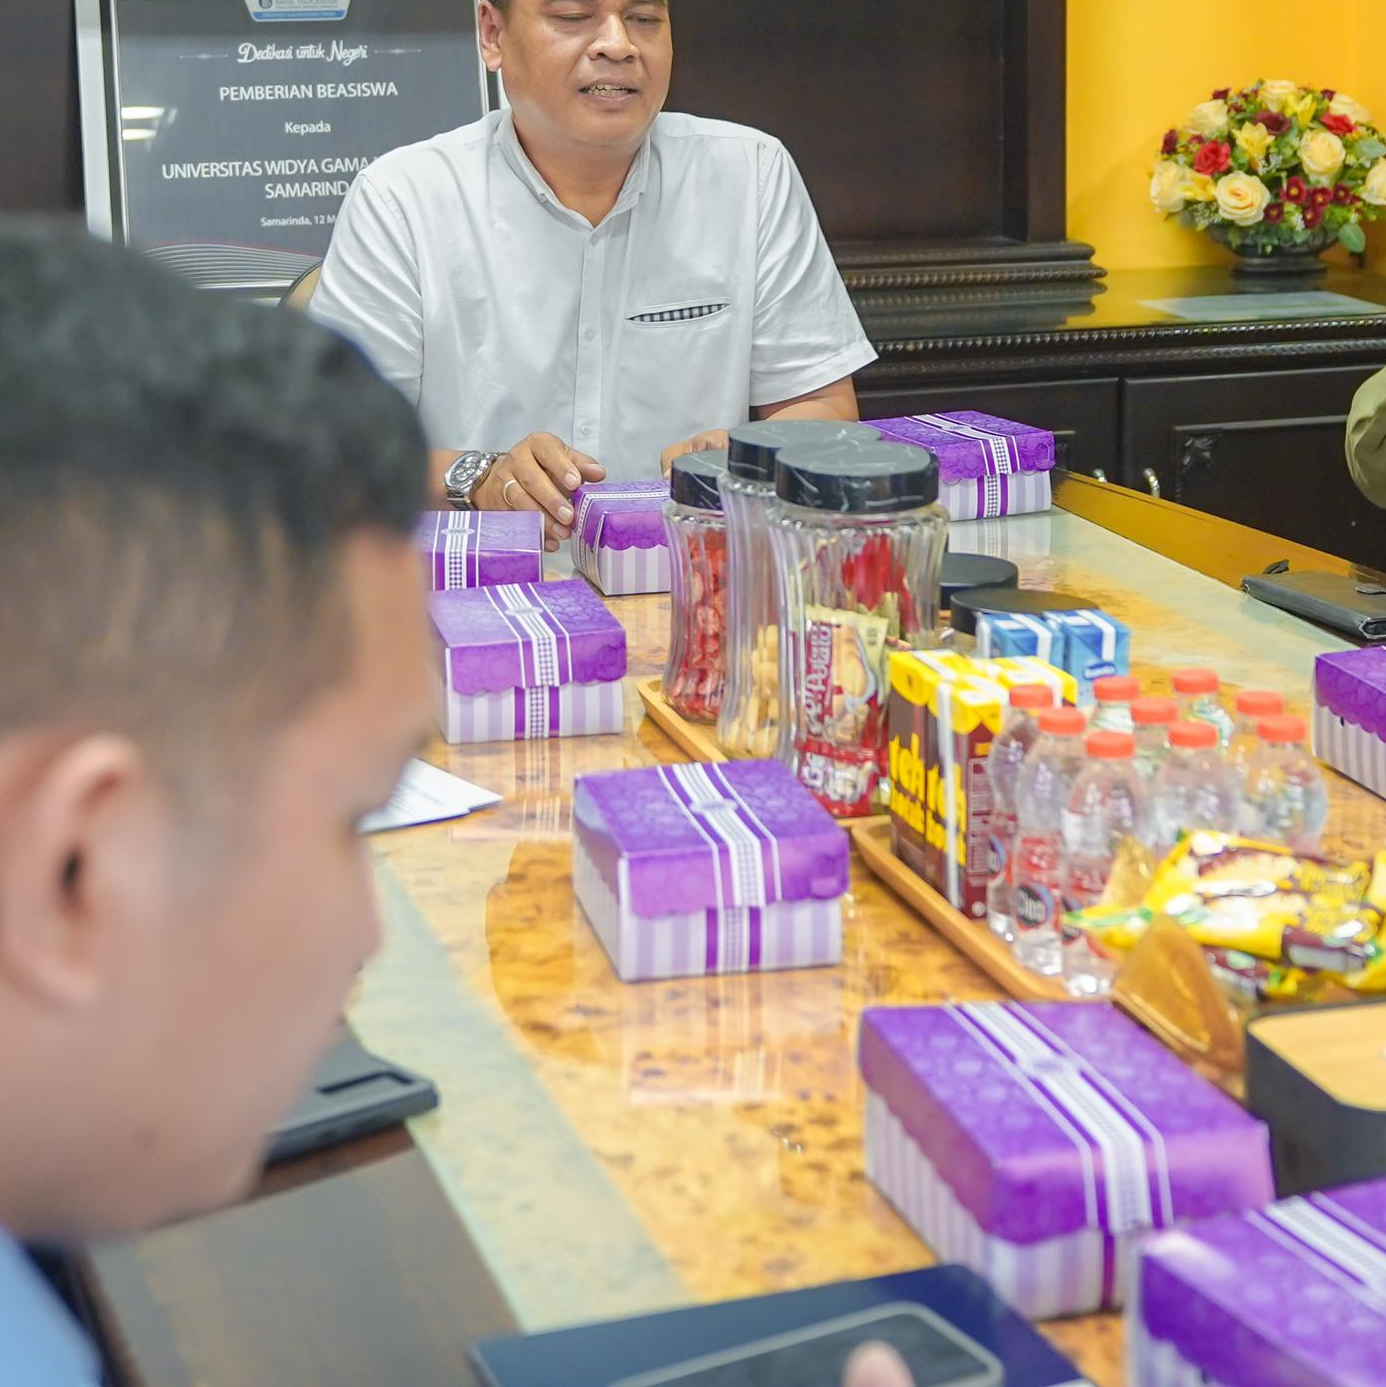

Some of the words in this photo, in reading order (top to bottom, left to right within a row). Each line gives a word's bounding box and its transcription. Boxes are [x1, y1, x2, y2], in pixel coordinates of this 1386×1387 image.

[237, 42, 294, 63] Dedikasi
[296, 43, 325, 59] untuk
[326, 40, 368, 66] Negeri
[219, 84, 313, 101] PEMBERIAN
[317, 82, 399, 99] BEASISWA
[285, 121, 331, 135] Kepada
[162, 161, 262, 180] UNIVERSITAS
[264, 159, 319, 175] WIDYA
[321, 156, 369, 173] GAMA
[265, 180, 350, 199] SAMARIND
[260, 215, 312, 227] Samarinda,
[314, 214, 325, 224] 12
[889, 733, 925, 807] teh
